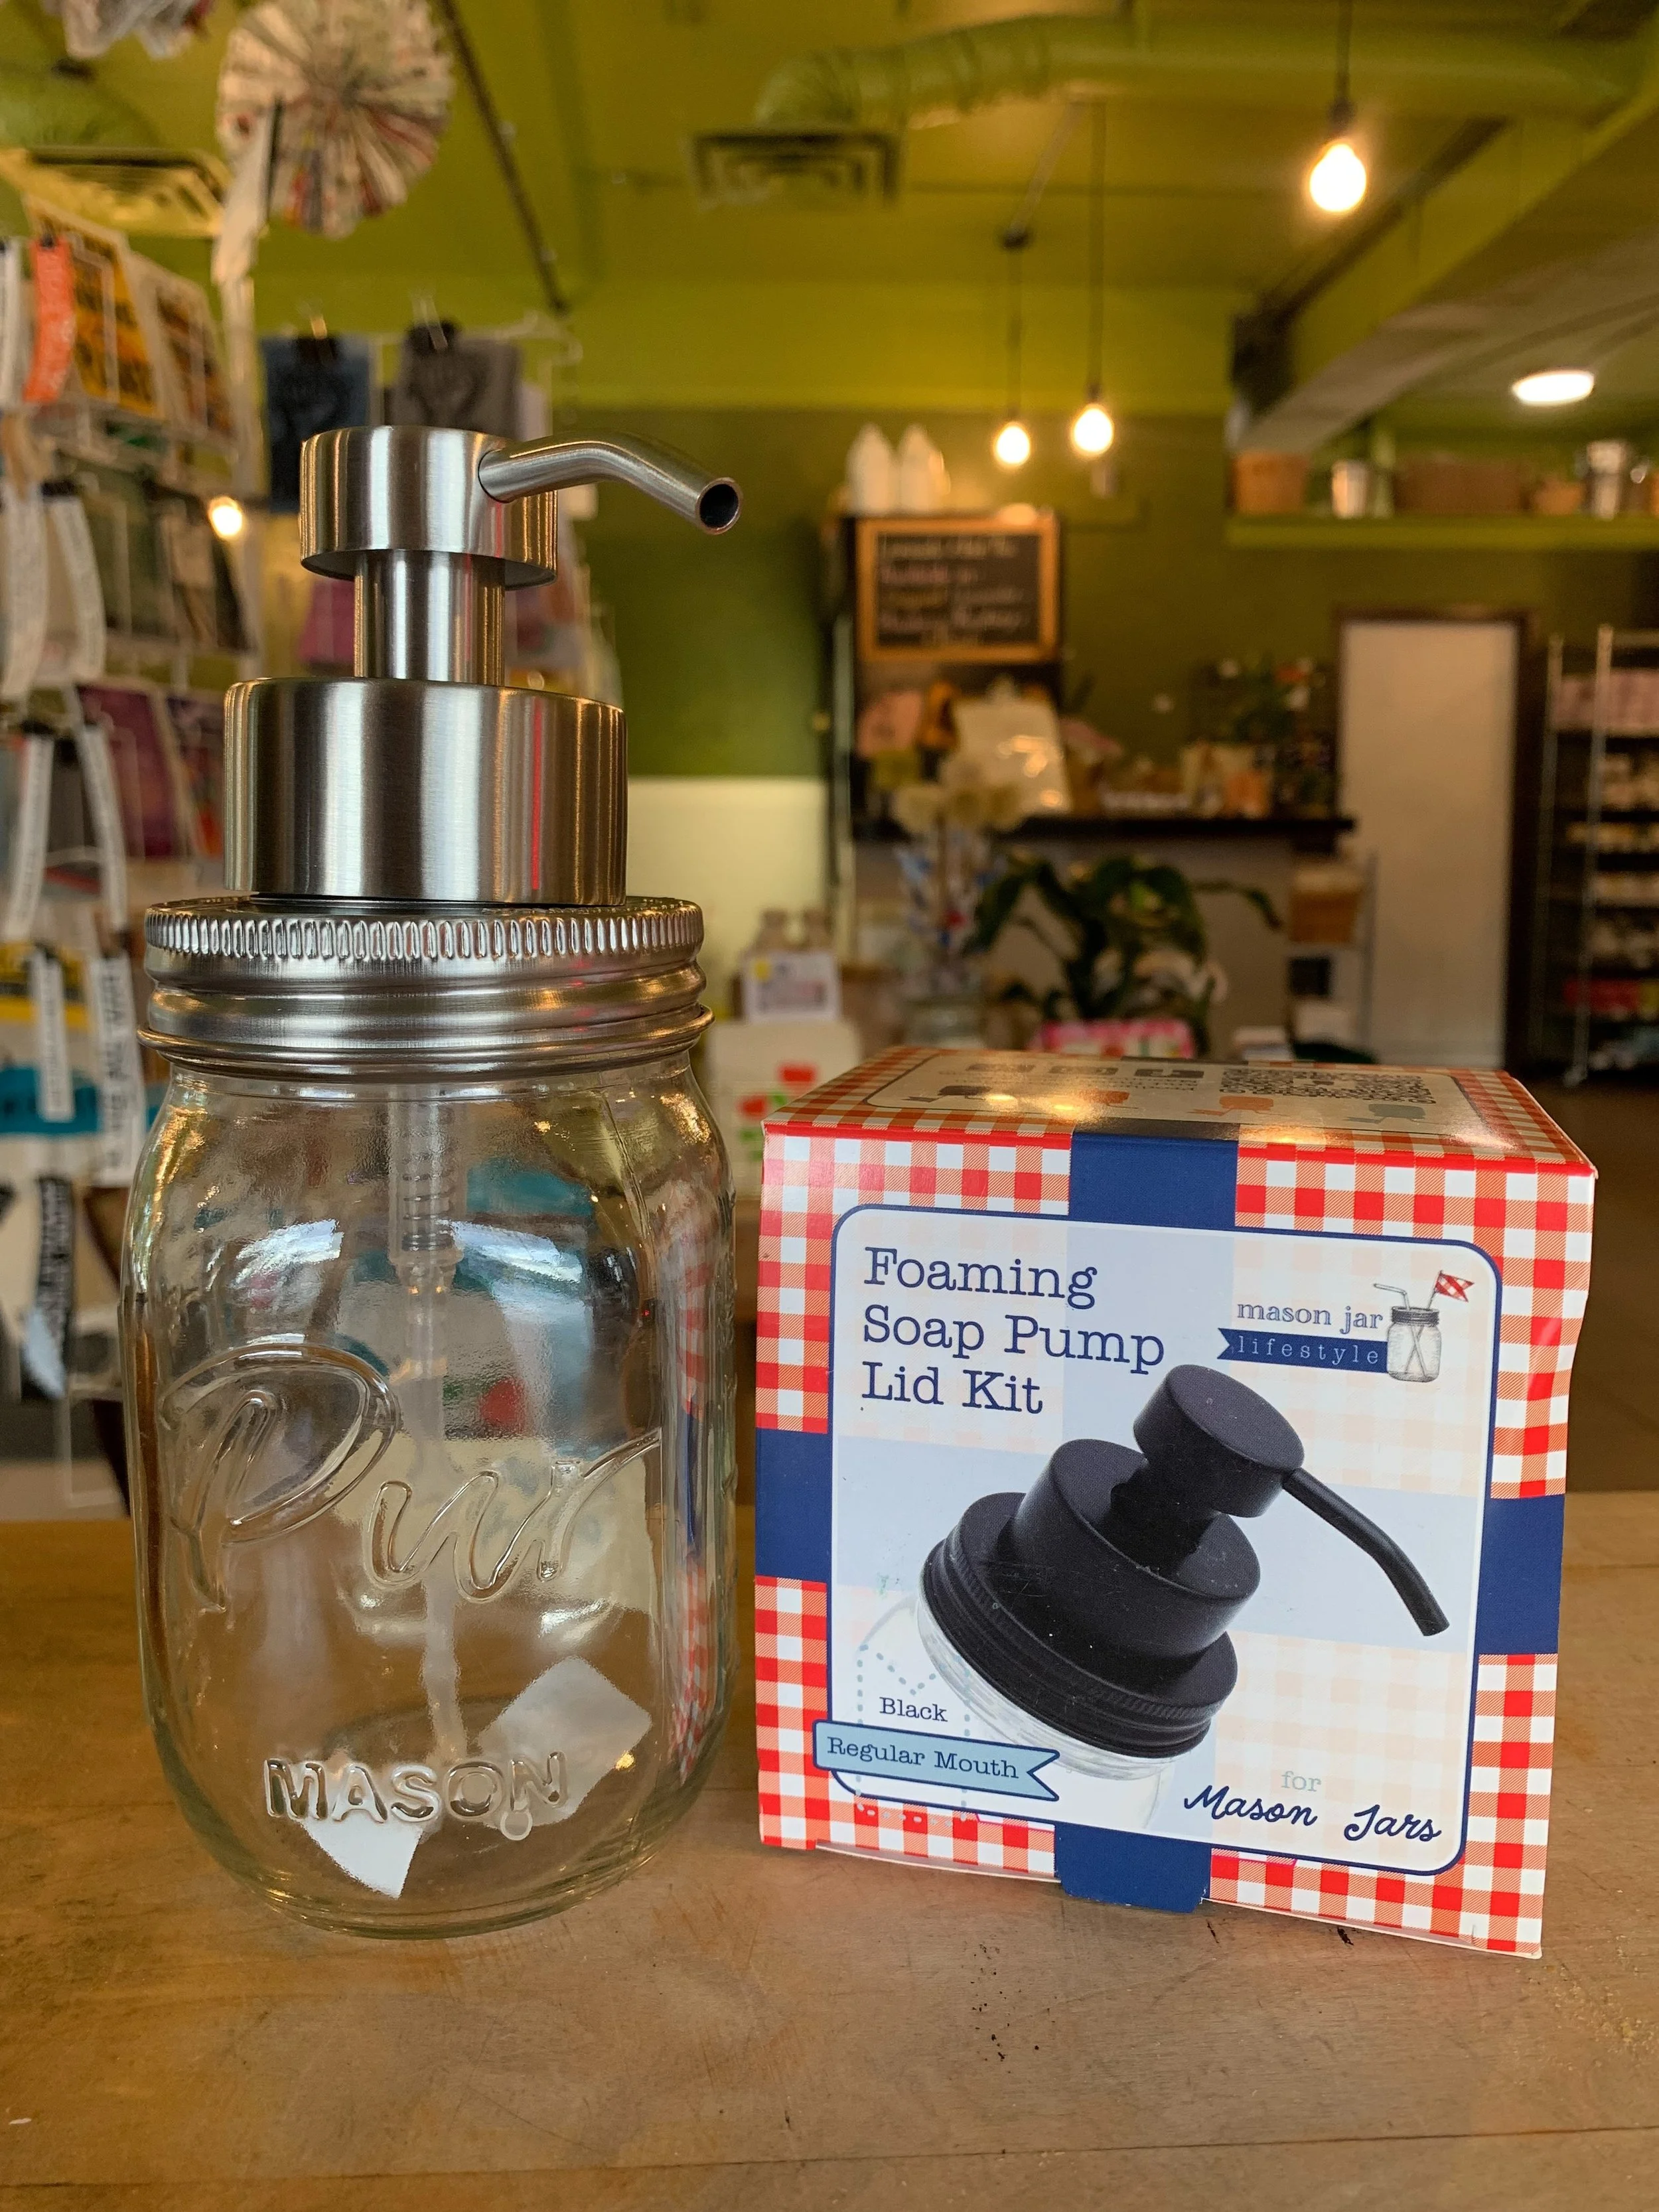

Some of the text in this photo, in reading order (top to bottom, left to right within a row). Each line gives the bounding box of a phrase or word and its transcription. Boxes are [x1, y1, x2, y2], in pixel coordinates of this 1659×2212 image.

[863, 1246, 1098, 1309] Foaming
[863, 1303, 1165, 1375] Soap Pump
[1237, 1303, 1384, 1335] mason jar
[1237, 1335, 1379, 1366] lifestyle
[861, 1361, 1044, 1414] Lid Kit
[879, 1696, 948, 1723] Black
[827, 1735, 1019, 1779] Regular Mouth
[263, 1750, 568, 1824] MASON
[1280, 1771, 1322, 1793] for
[1183, 1784, 1442, 1842] Mason Jars
